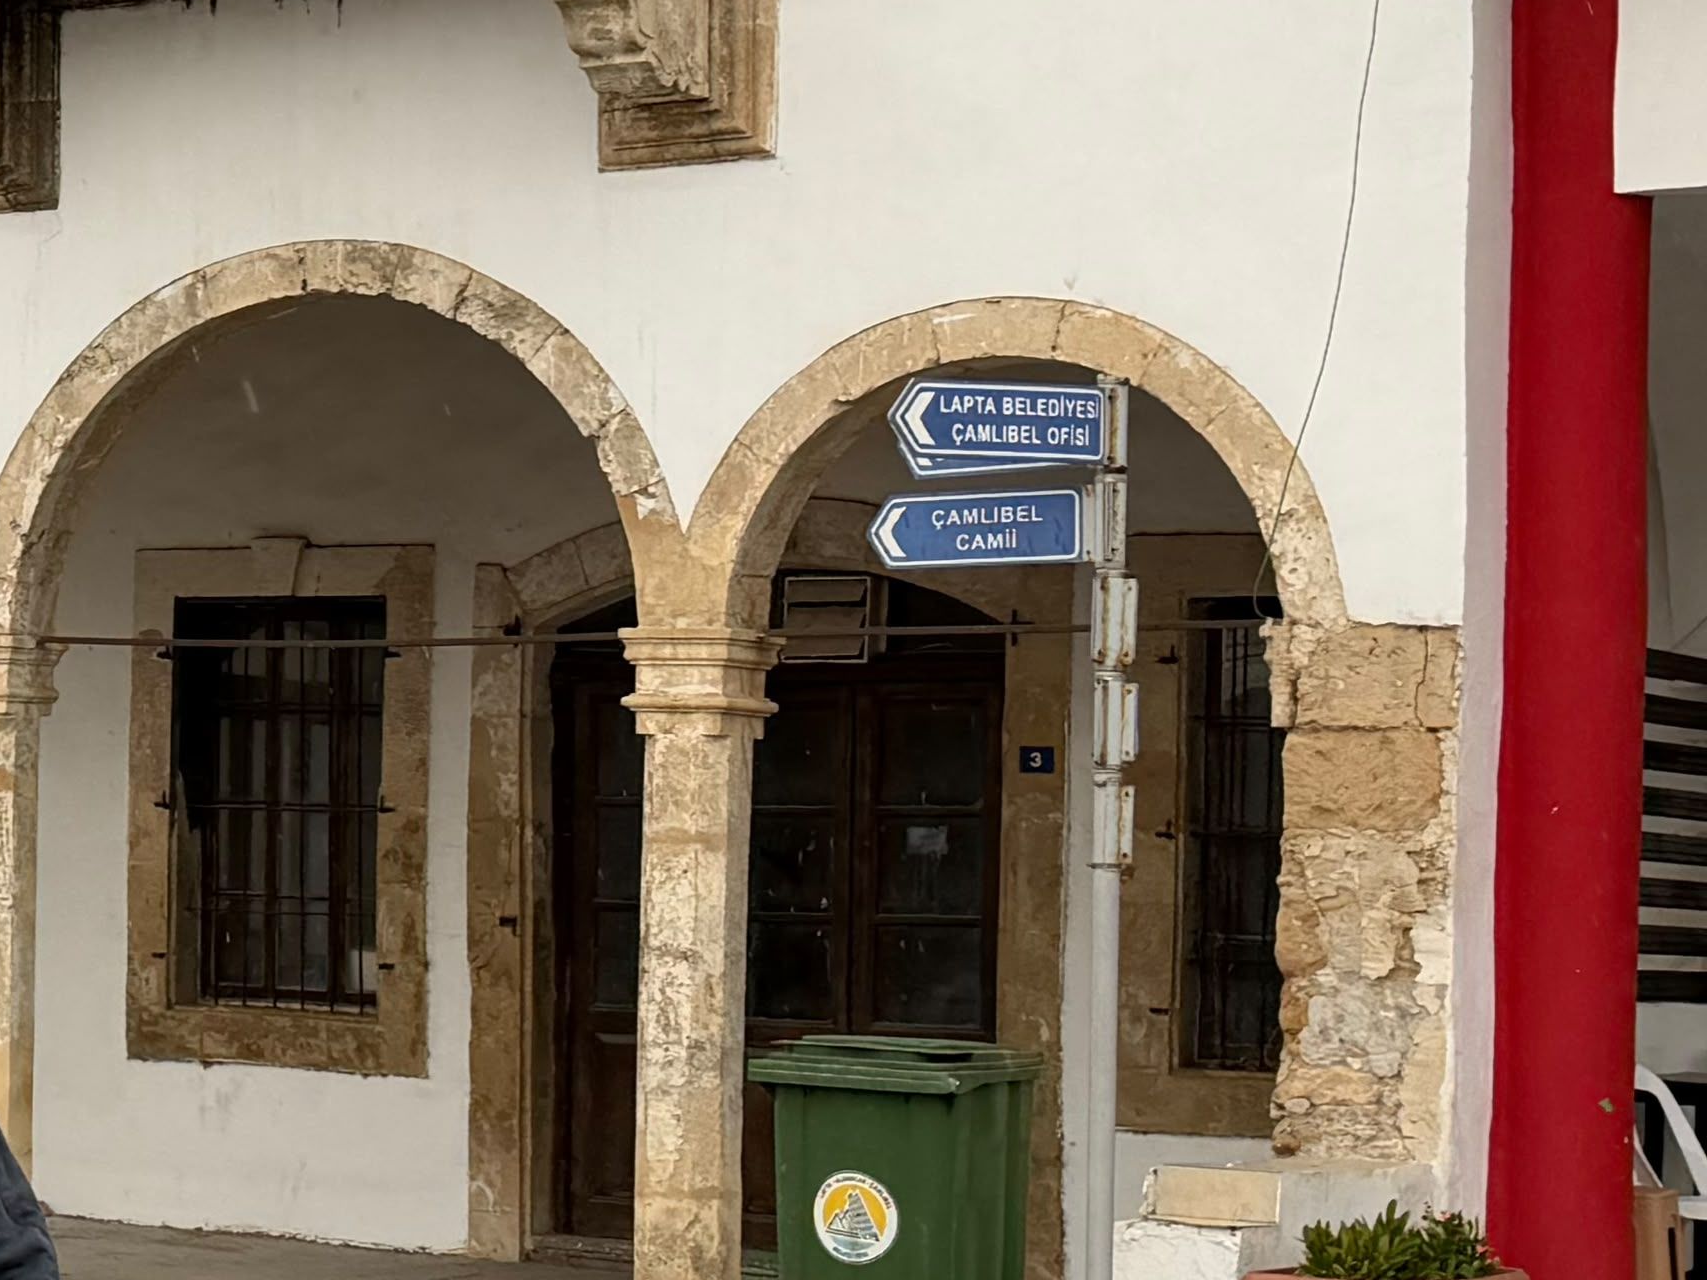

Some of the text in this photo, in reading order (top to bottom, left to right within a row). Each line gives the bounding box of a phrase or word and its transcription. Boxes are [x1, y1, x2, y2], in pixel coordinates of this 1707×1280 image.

[940, 395, 1099, 419] LAPTA BELEDİYESİ
[952, 424, 1090, 446] ÇAMLIBEL OFİSİ
[931, 505, 1043, 529] ÇAMLIBEL
[955, 528, 1017, 551] CAMİİ
[1029, 752, 1043, 768] 3
